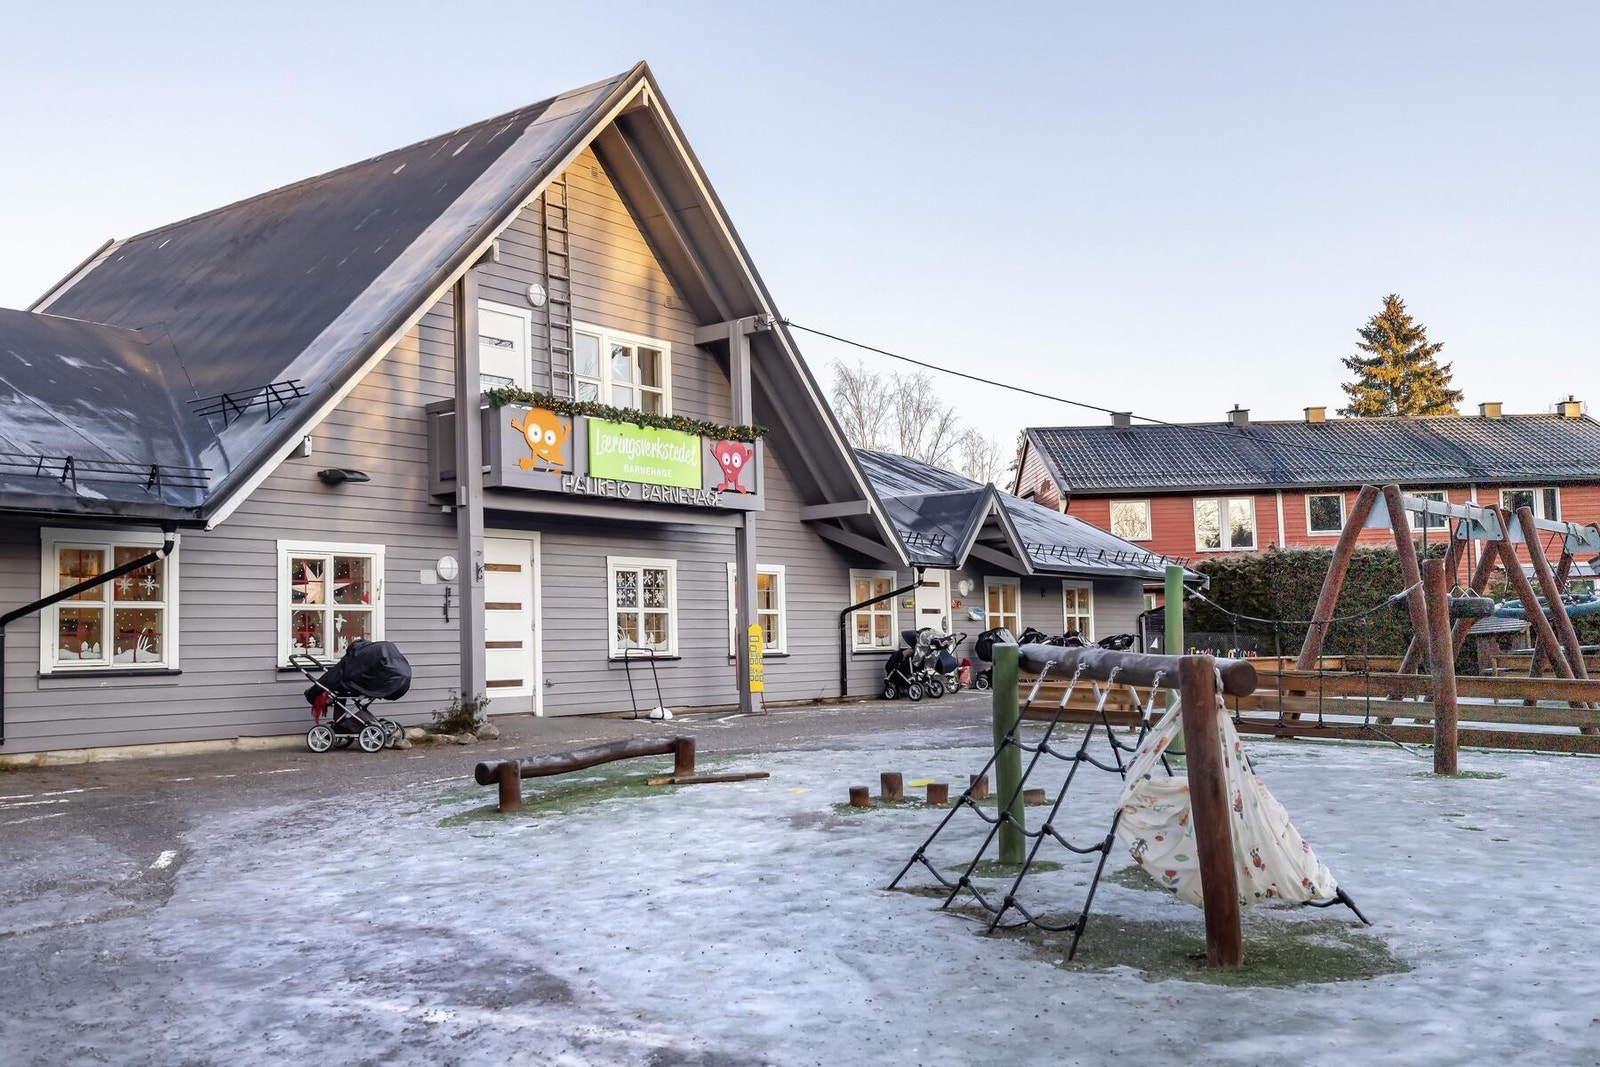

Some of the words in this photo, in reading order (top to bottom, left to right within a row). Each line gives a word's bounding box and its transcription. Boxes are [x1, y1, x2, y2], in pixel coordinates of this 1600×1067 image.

[595, 428, 697, 466] Læringsverkstedet
[623, 463, 673, 478] BARNEHAGE
[642, 484, 723, 507] BARNEHAGE
